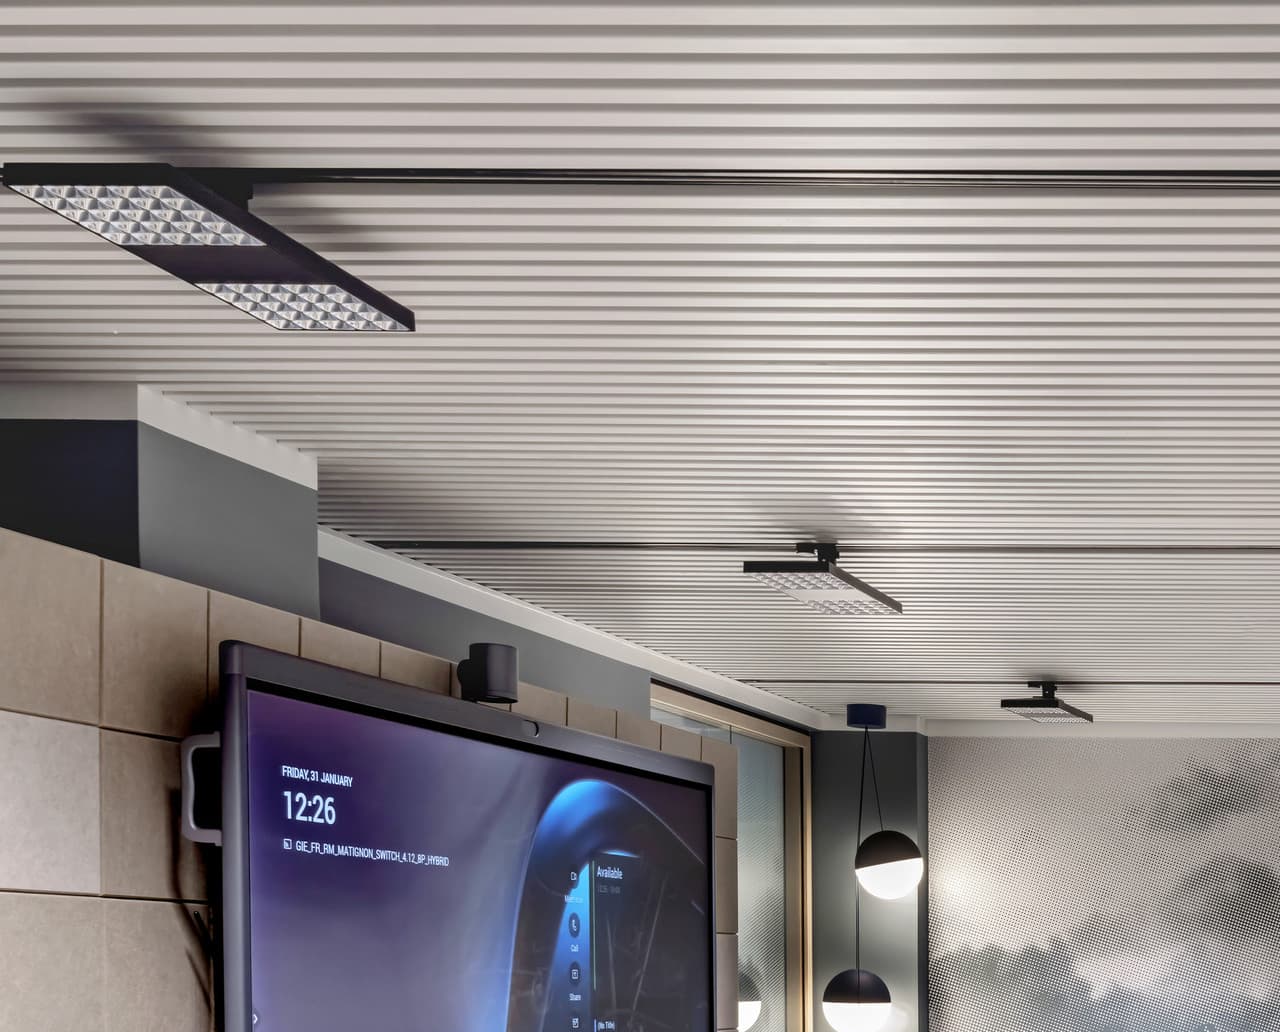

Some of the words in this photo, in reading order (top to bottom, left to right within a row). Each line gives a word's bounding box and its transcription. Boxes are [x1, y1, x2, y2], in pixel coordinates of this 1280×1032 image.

[282, 765, 309, 782] FRIDAY,
[310, 770, 319, 782] 31
[320, 772, 353, 787] JANUARY
[283, 791, 336, 825] 12:26
[596, 866, 623, 880] Available
